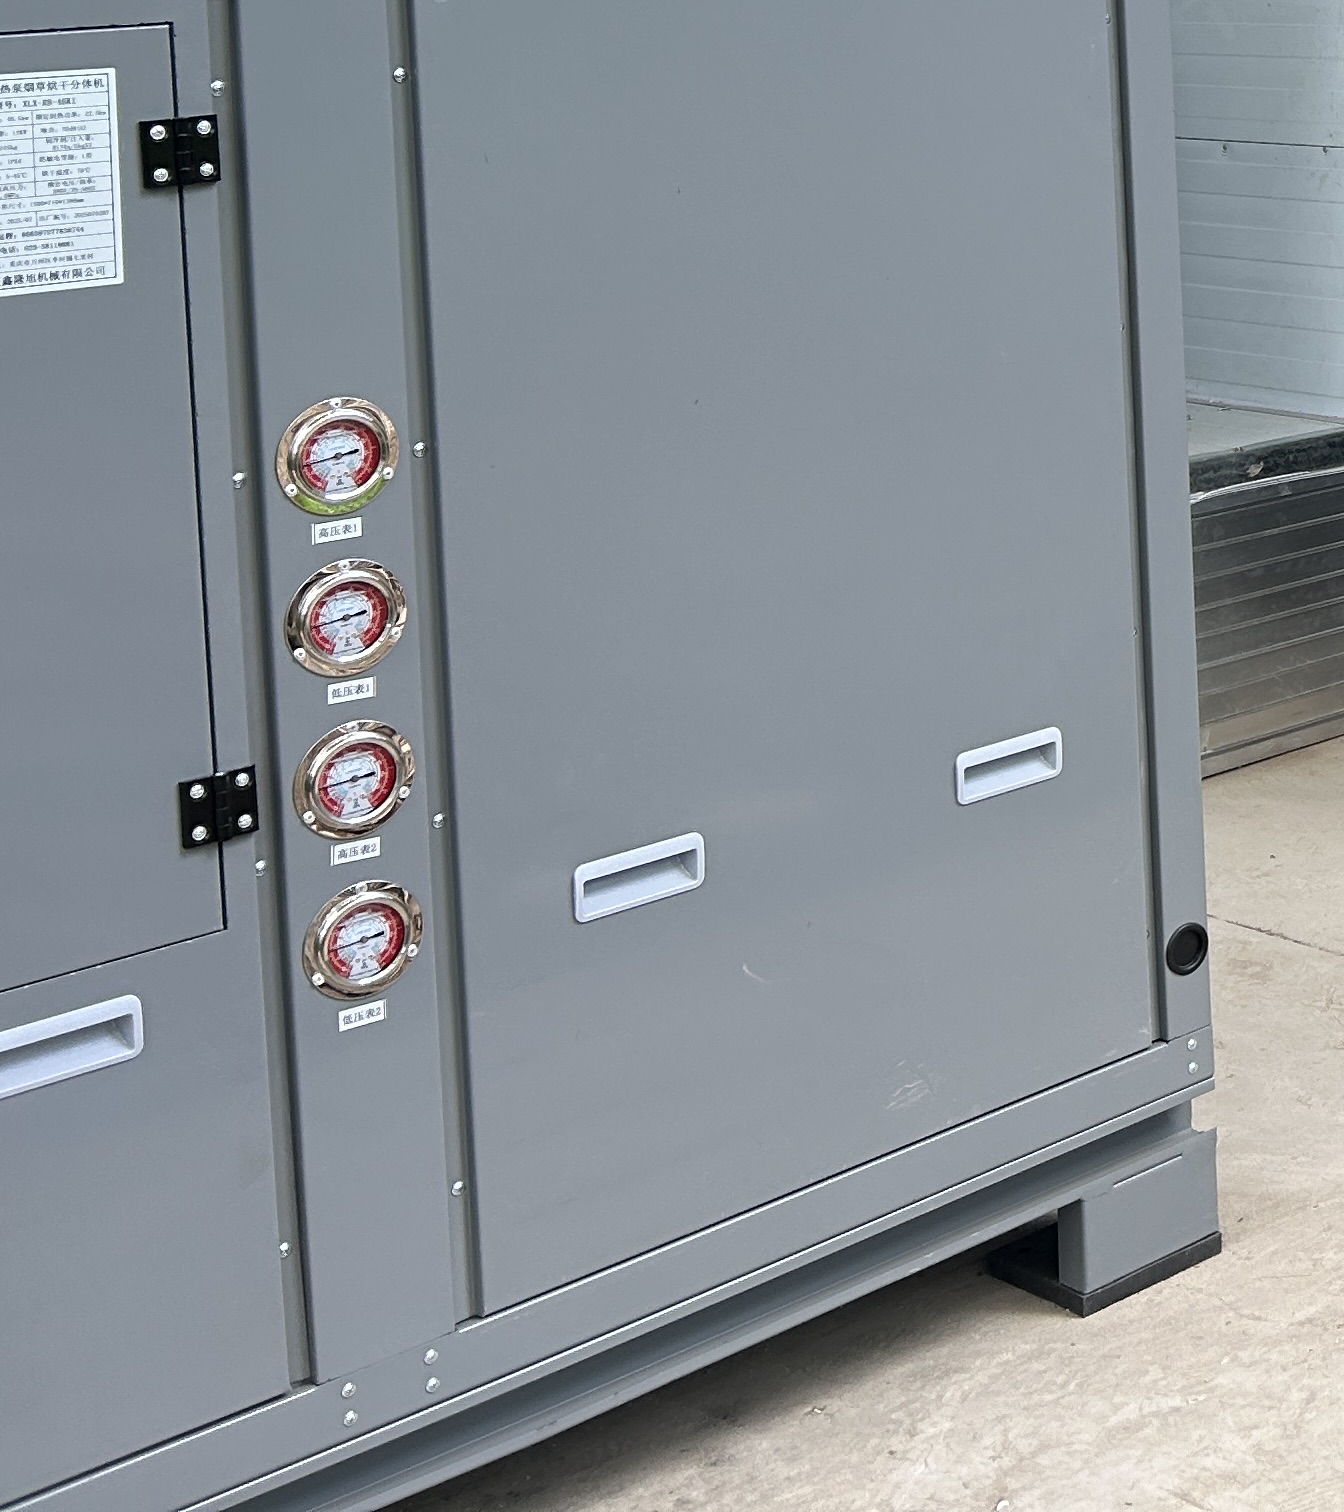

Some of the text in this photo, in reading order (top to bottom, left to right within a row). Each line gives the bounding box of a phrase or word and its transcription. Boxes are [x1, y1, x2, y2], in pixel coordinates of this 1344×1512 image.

[318, 523, 358, 539] 高压表1
[331, 682, 370, 700] 低压表1
[337, 842, 378, 860] 高压表2
[342, 1006, 382, 1026] 低压表2
